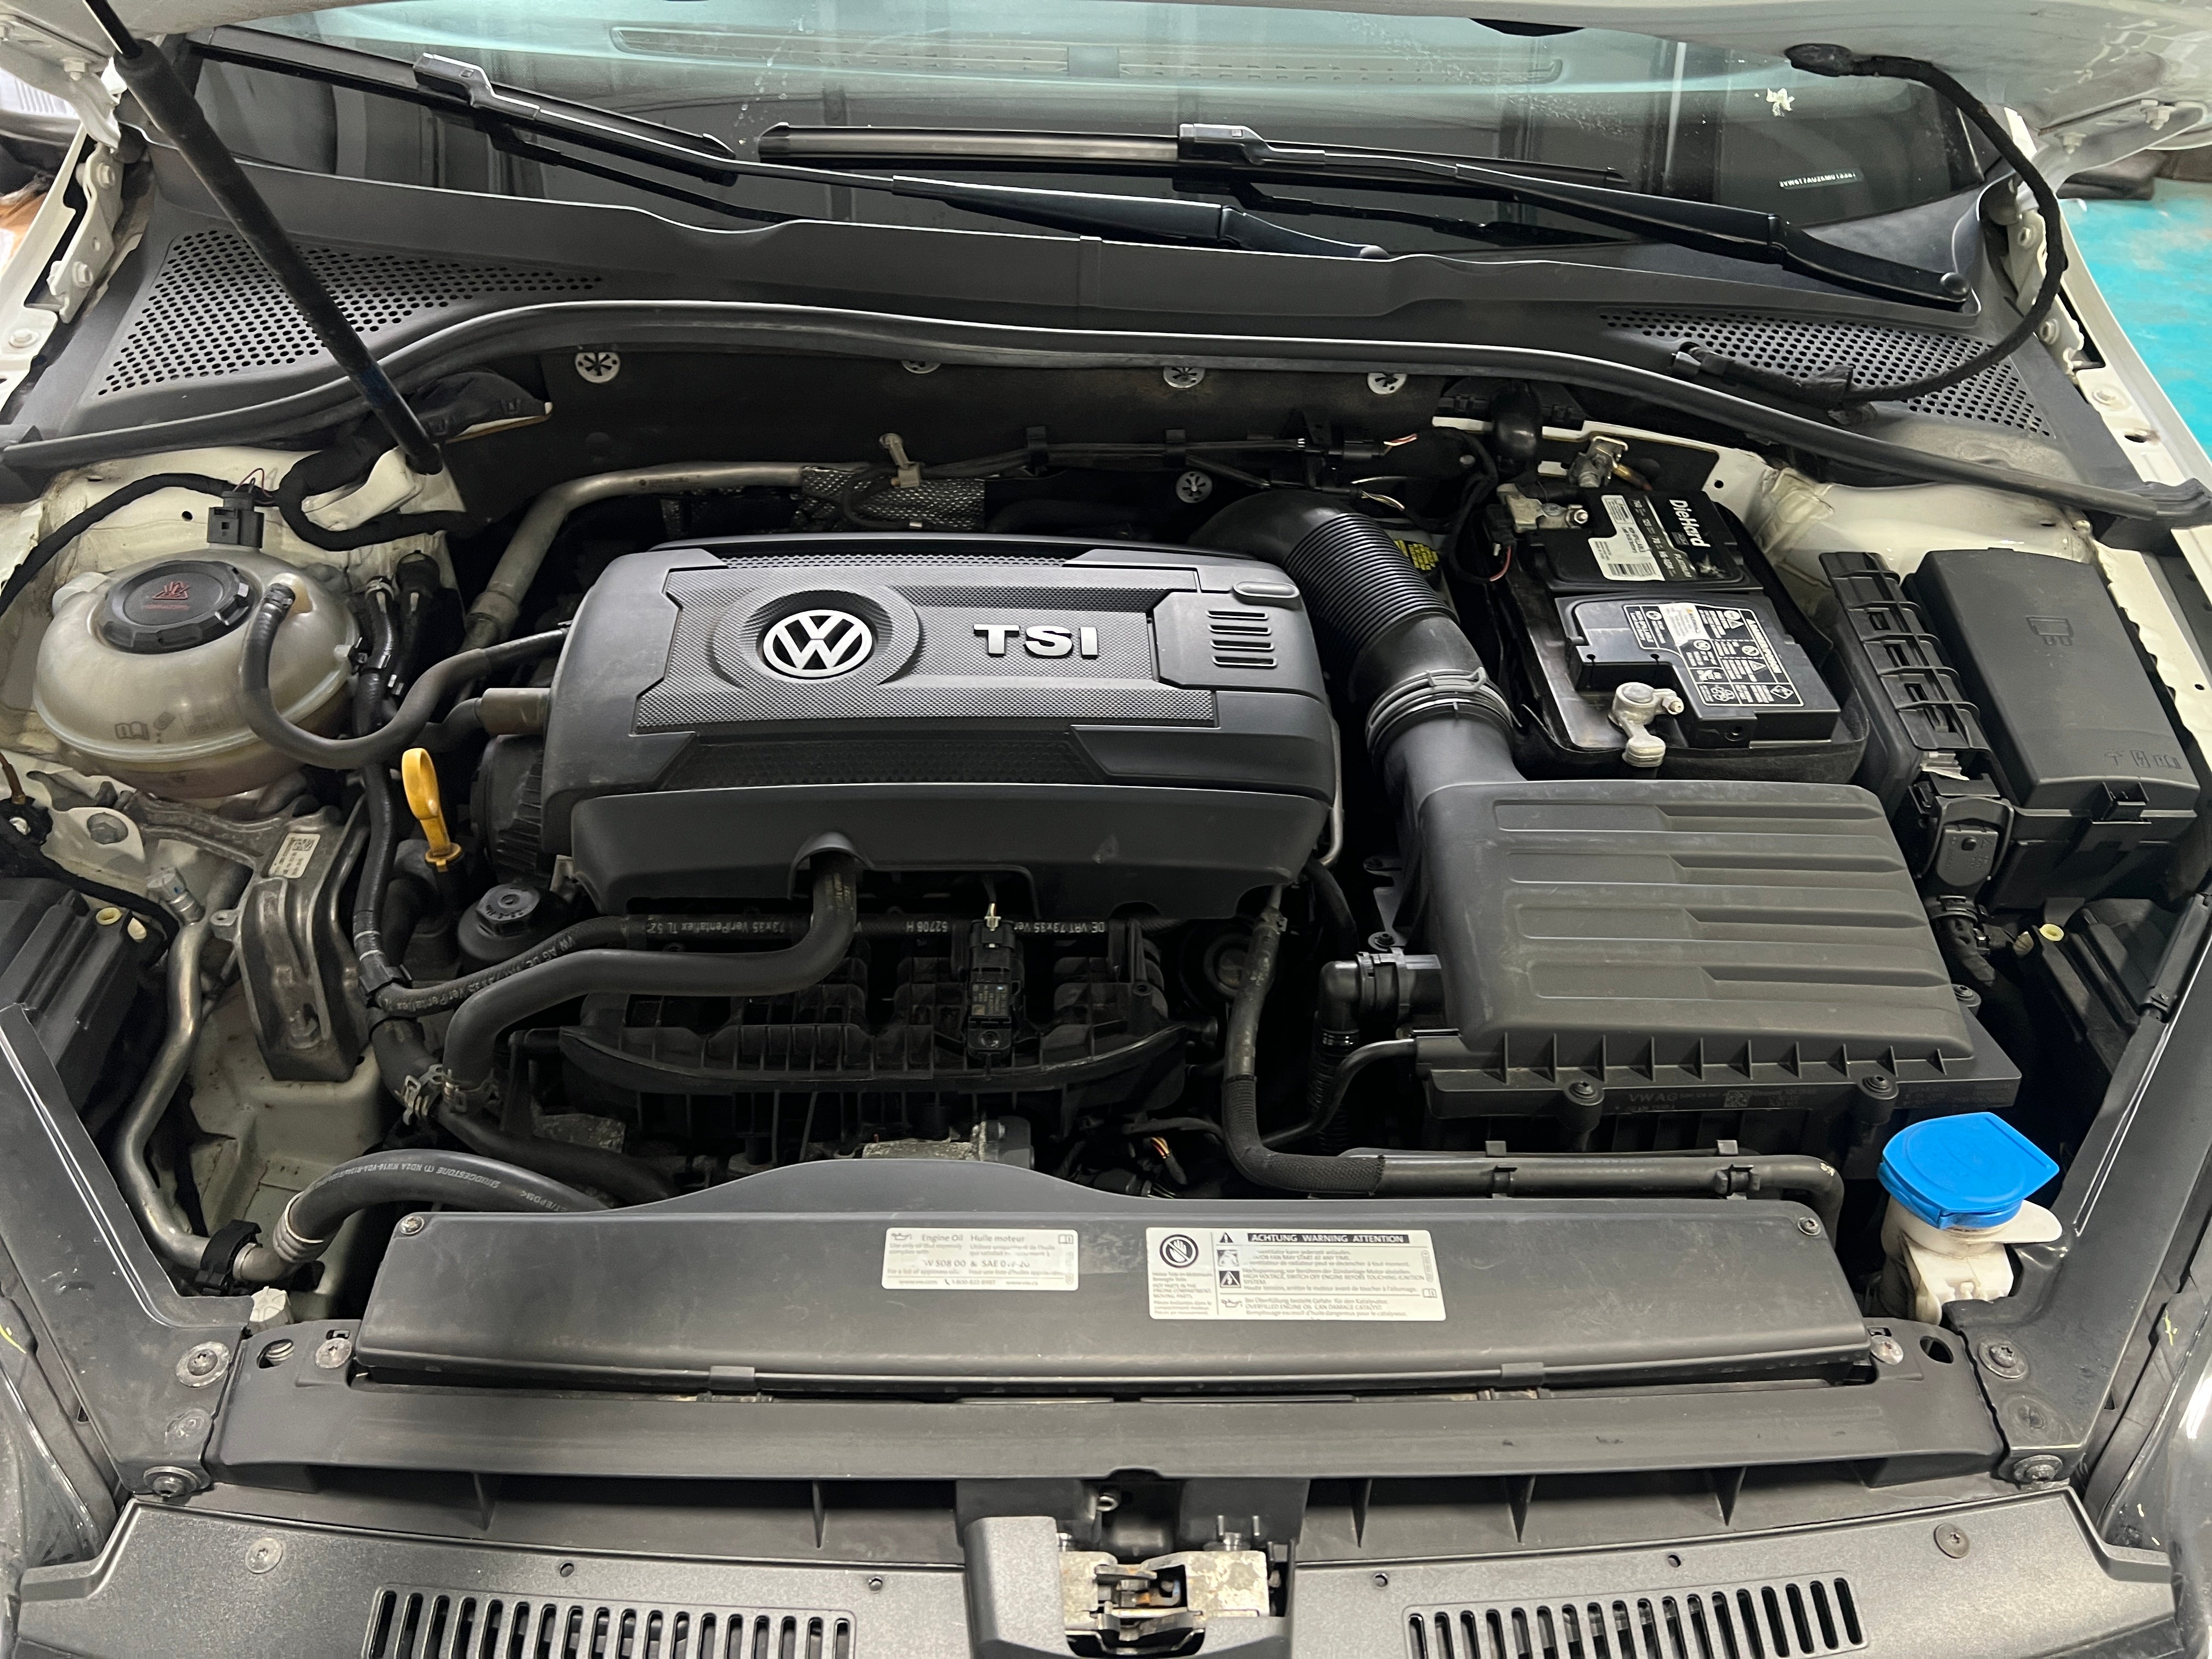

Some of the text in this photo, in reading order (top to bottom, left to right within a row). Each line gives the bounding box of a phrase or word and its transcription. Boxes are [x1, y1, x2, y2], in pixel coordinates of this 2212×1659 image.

[1669, 499, 1711, 547] DieHard
[973, 623, 1099, 659] TSI
[906, 921, 948, 933] 52706 H
[436, 1166, 501, 1189] BRIDGESTONE
[922, 1234, 950, 1243] Engine
[1251, 1234, 1404, 1243] ACHTUNG WARNING ATTENTION
